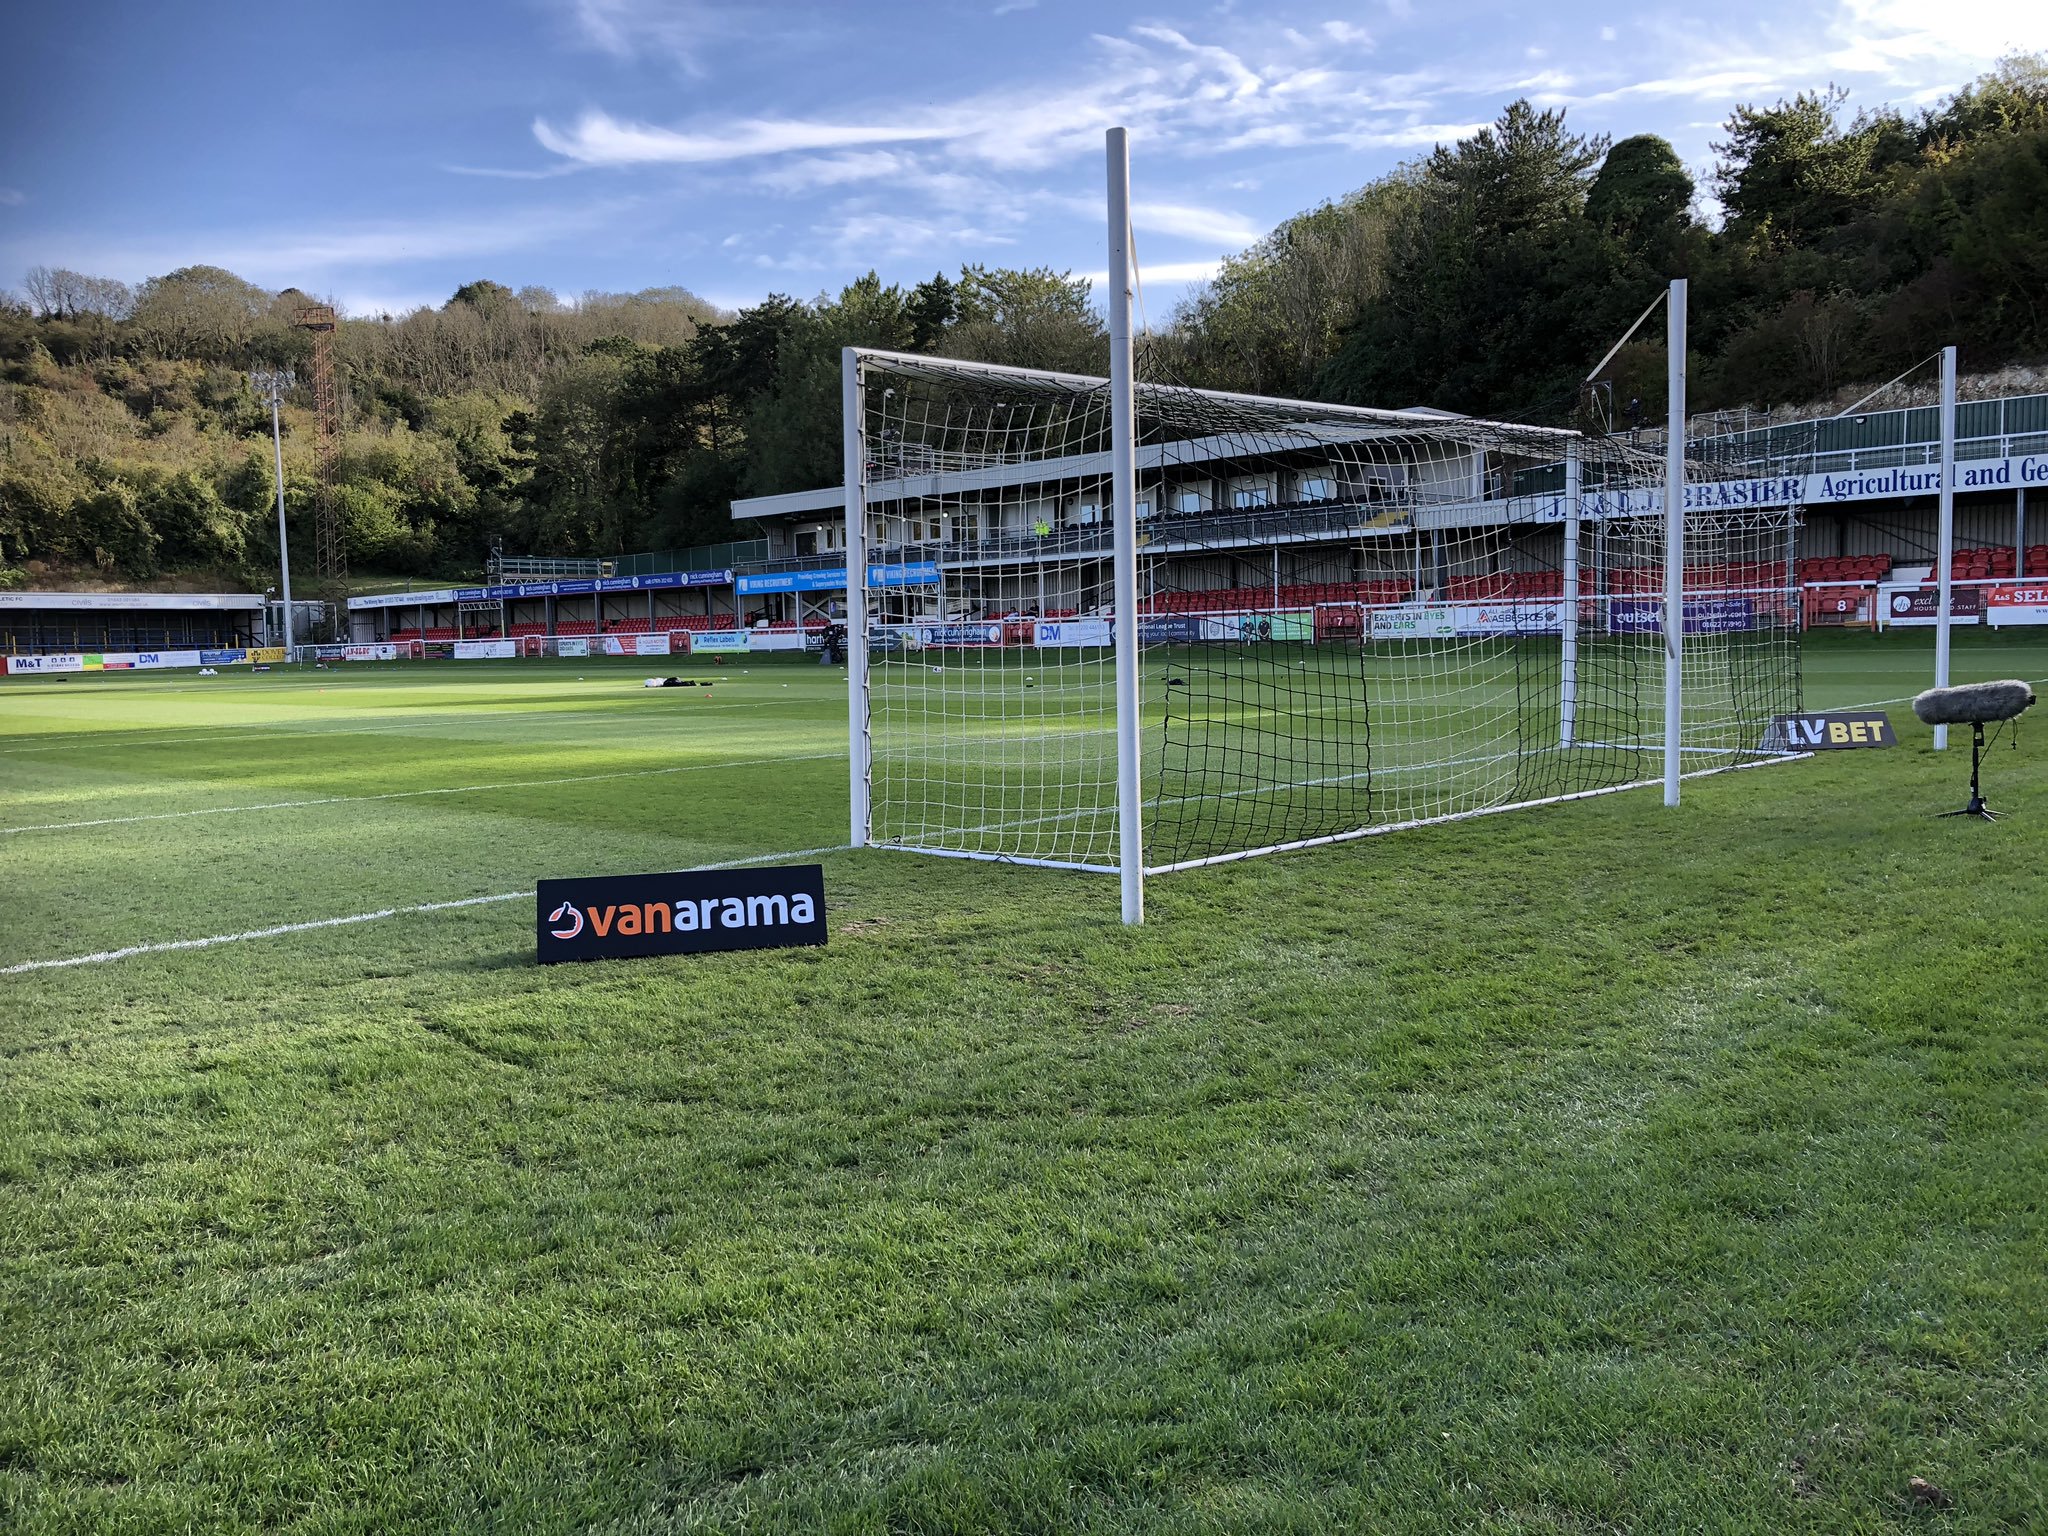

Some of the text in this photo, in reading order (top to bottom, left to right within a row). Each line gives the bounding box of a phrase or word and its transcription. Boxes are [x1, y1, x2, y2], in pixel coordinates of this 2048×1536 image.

[1965, 460, 2010, 486] and
[2021, 457, 2048, 482] Ge
[749, 580, 763, 589] VIKING
[2014, 590, 2048, 603] SEL
[1837, 600, 1846, 611] 8
[1337, 617, 1343, 626] 7
[1374, 611, 1445, 622] EXPERTS IN EYES
[1492, 613, 1543, 623] ASBESTOS
[1374, 620, 1416, 630] AND EARS
[719, 635, 735, 643] Labels
[16, 658, 42, 669] M&T
[586, 893, 815, 937] vanarama
